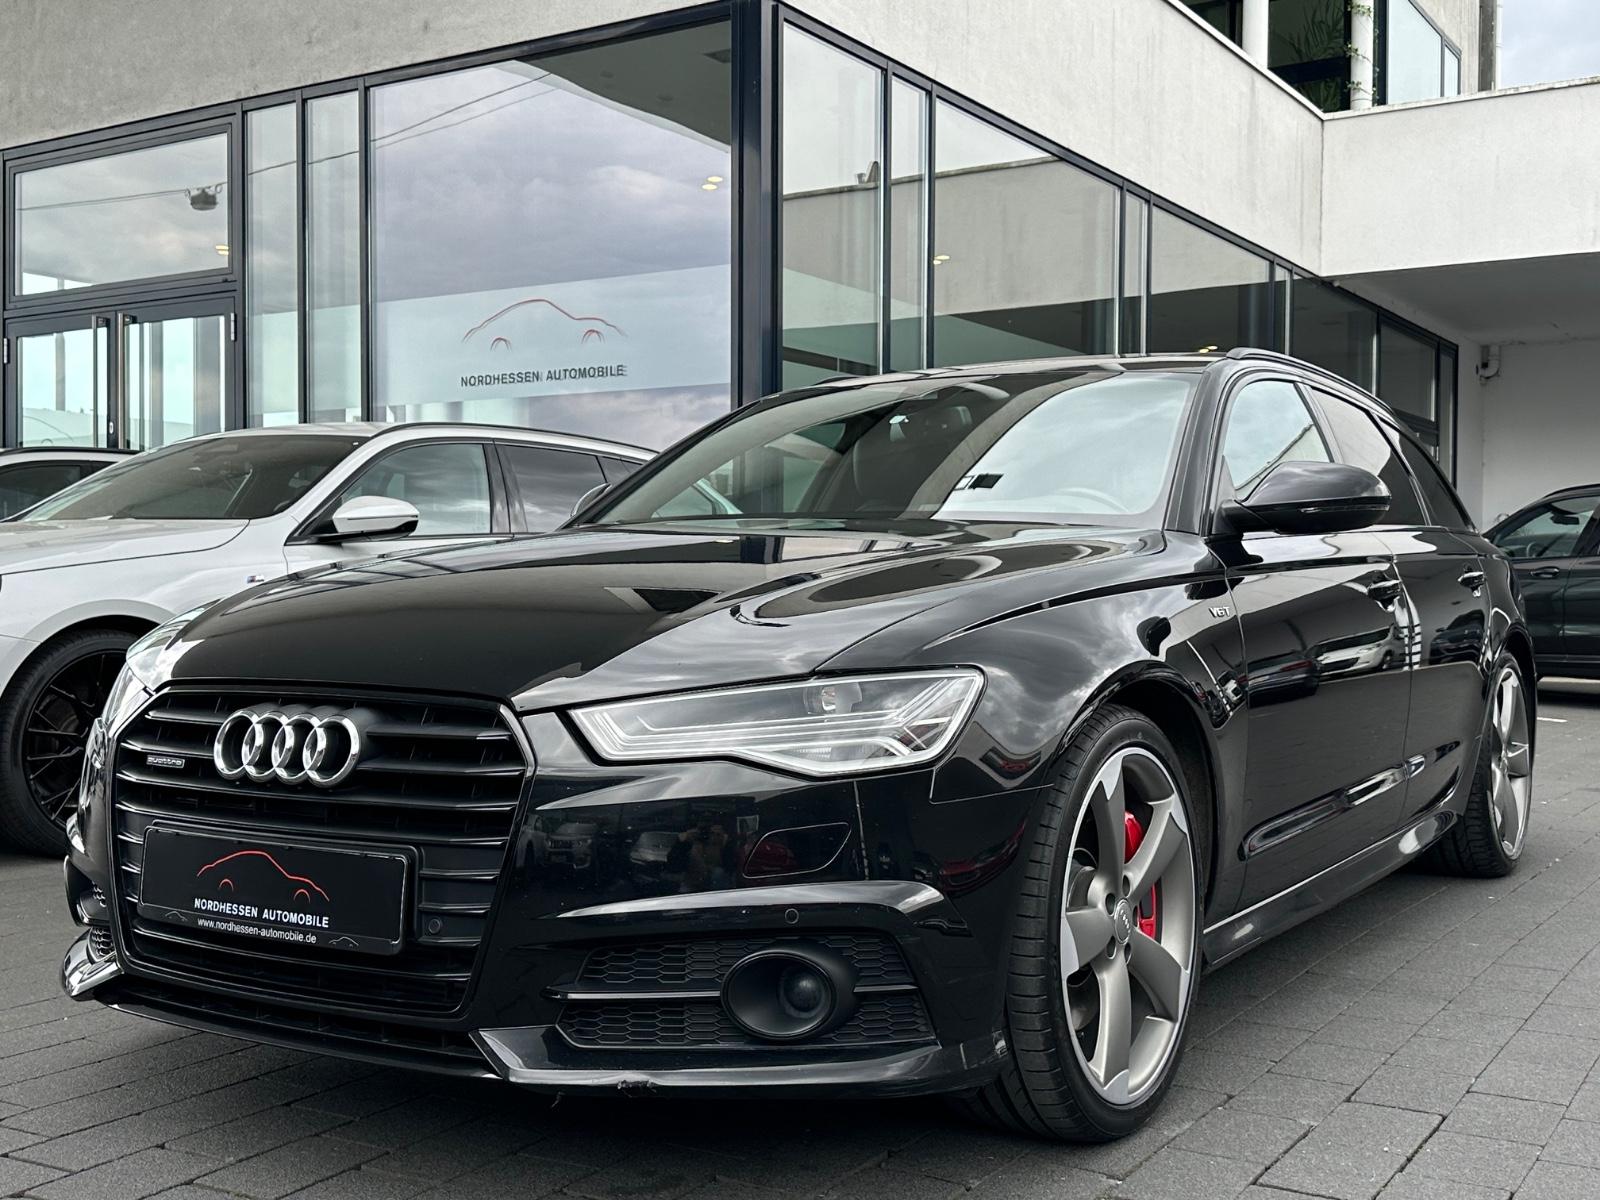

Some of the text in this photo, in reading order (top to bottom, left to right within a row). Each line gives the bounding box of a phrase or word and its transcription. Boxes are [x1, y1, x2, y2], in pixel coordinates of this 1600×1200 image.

[461, 365, 625, 387] NORDHESSEN AUTOMOBILE
[194, 898, 330, 928] NORDHESSEN AUTOMOBILE
[197, 918, 317, 944] www.nordhessen-automobile.de
